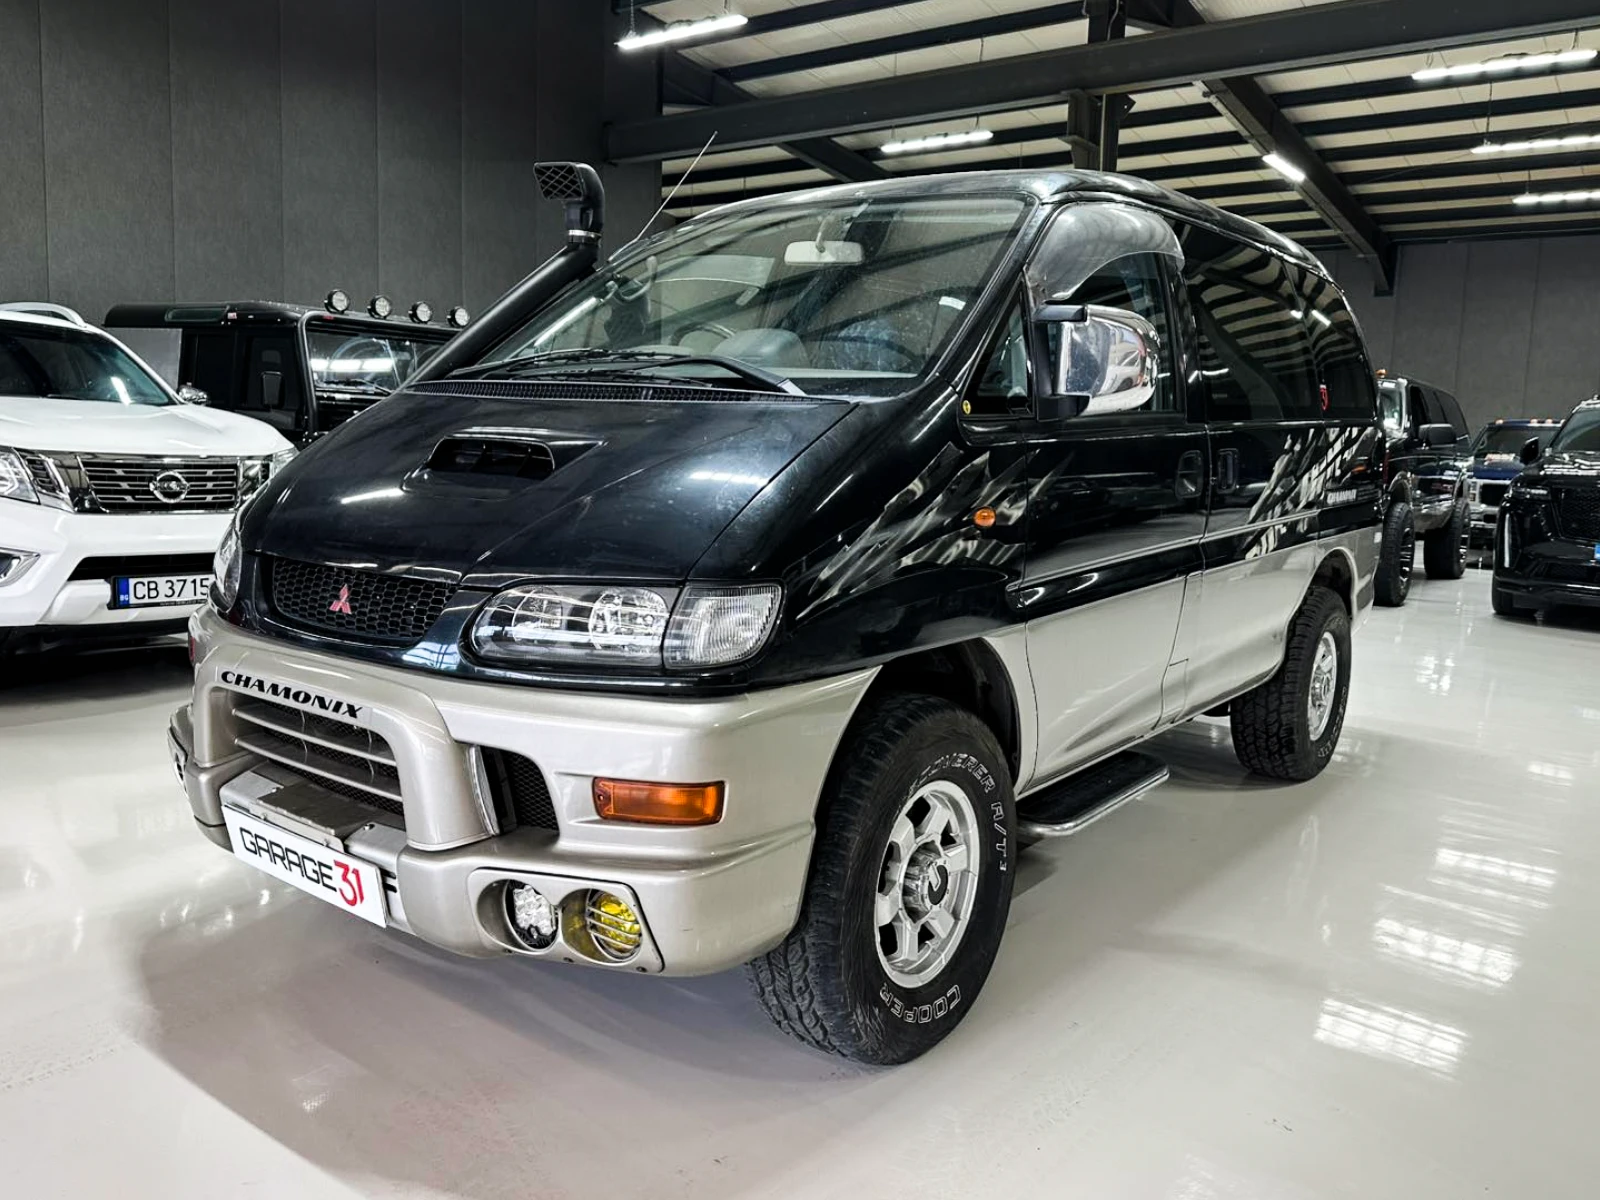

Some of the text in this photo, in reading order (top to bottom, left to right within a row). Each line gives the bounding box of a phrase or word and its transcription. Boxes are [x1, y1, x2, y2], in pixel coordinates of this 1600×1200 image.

[133, 577, 209, 600] CB 3715
[220, 670, 363, 719] CHAMONIX
[239, 826, 365, 907] GARAGE31
[879, 982, 961, 1024] COOPER
